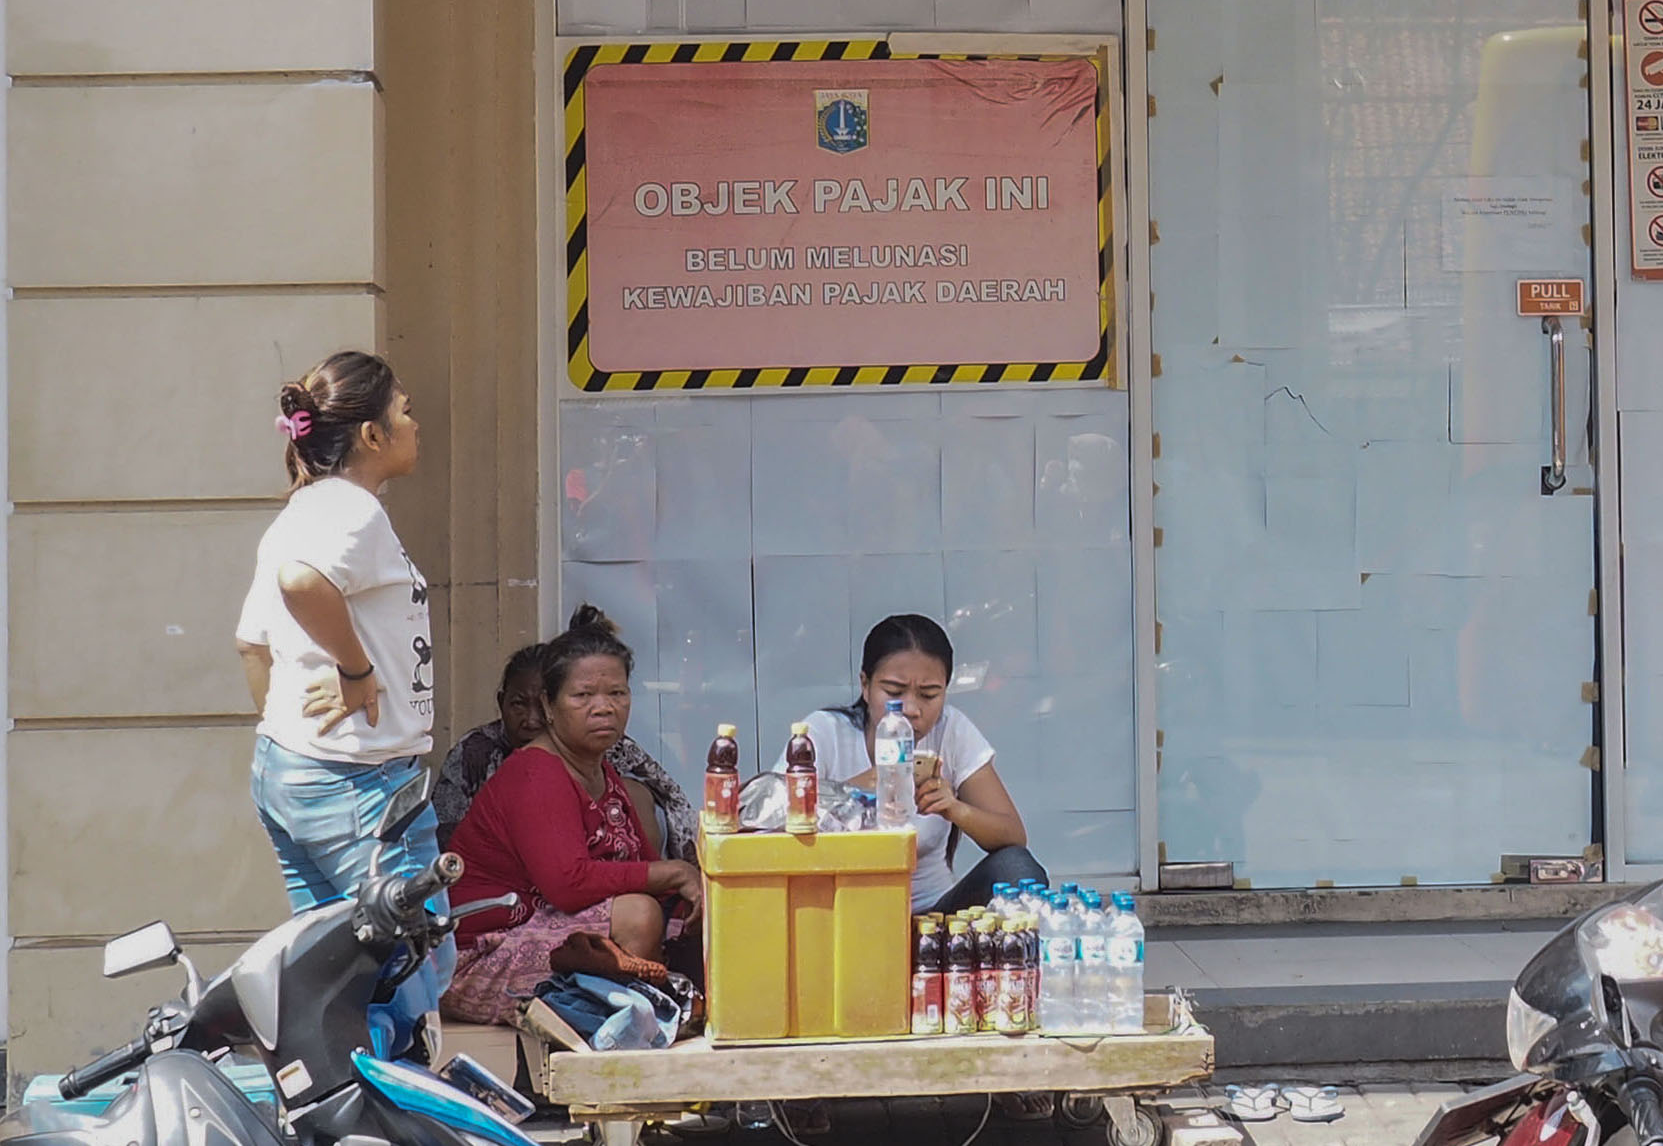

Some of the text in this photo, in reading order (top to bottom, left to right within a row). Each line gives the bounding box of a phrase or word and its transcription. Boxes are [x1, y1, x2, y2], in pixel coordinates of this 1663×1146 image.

[1637, 99, 1652, 110] 24
[634, 176, 1049, 217] OBJEK PAJAK INI
[686, 245, 968, 272] BELUM MELUNASI
[622, 278, 1065, 309] KEWAJIBAN PAJAK DAERAH
[1531, 284, 1571, 298] PULL
